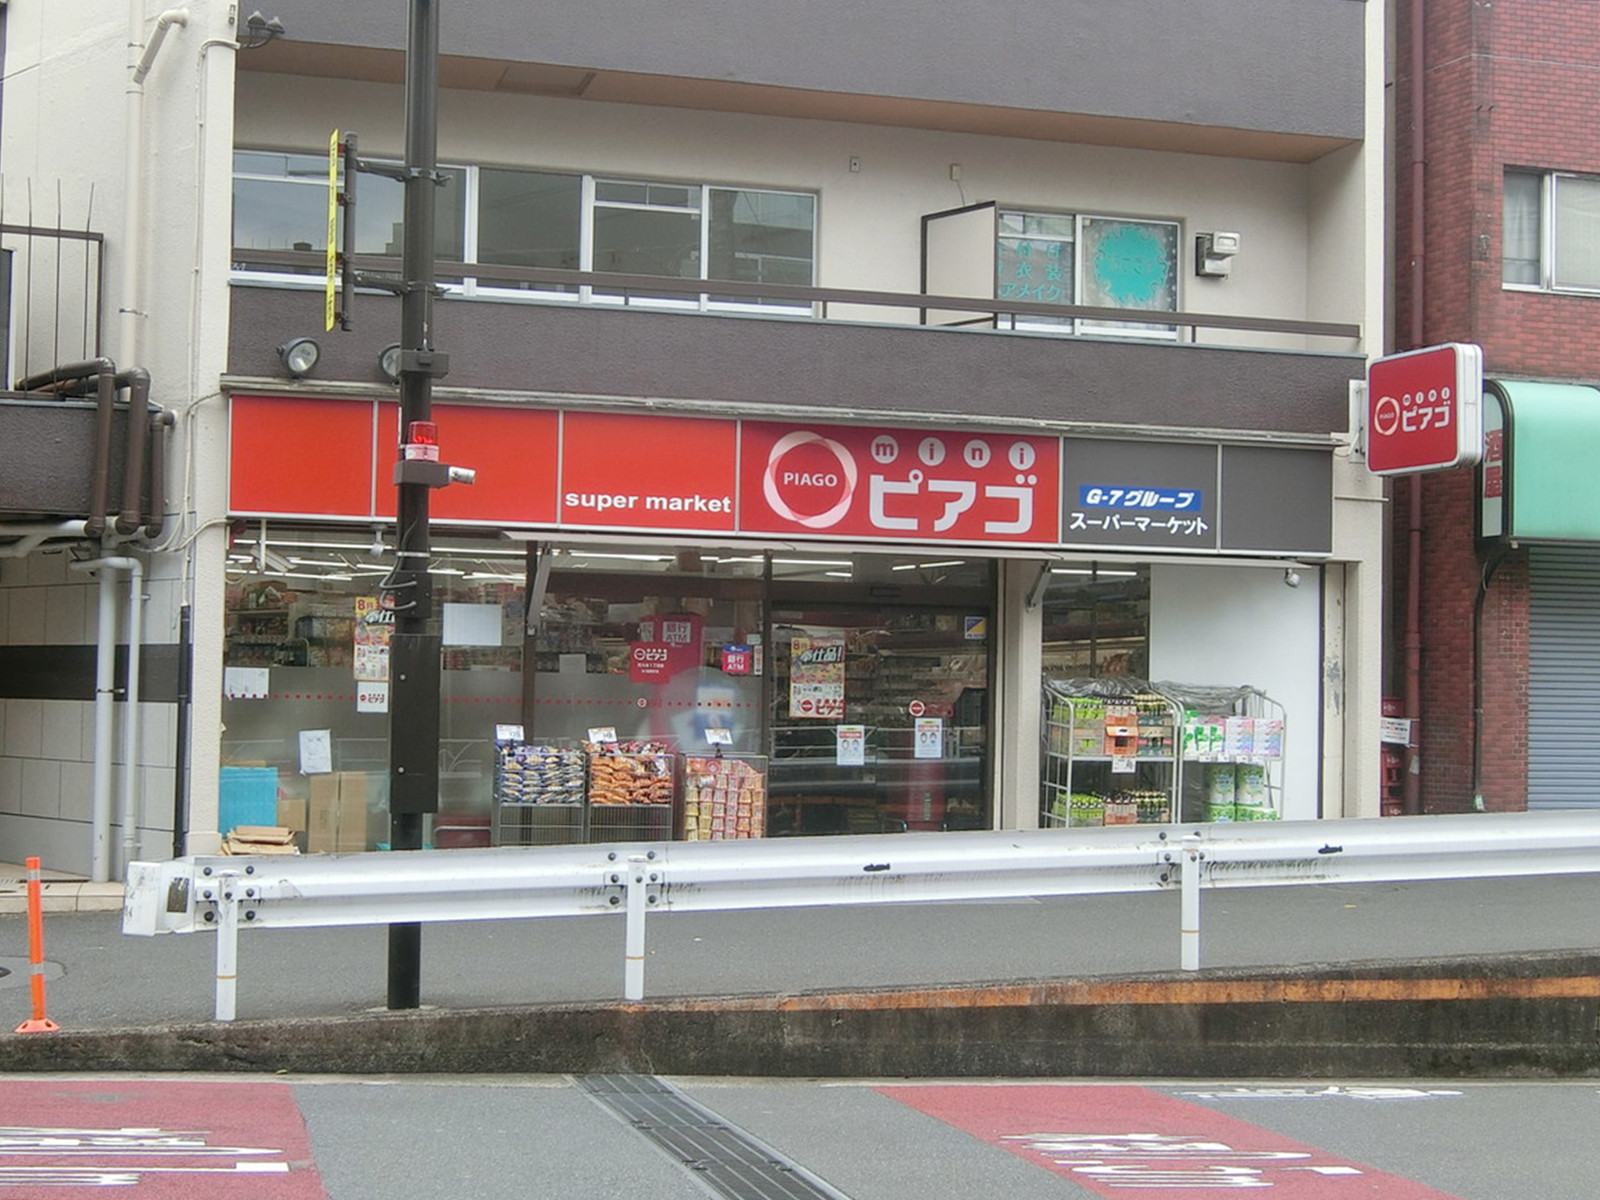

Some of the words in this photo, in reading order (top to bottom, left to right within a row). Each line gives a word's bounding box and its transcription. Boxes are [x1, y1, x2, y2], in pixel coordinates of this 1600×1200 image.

[1402, 400, 1451, 432] ピアゴ
[783, 472, 838, 487] PIAGO
[565, 492, 639, 512] super
[645, 494, 732, 513] market
[869, 469, 1037, 534] ピアゴ
[1069, 512, 1209, 535] スーパーマーケット
[727, 663, 744, 671] ATM
